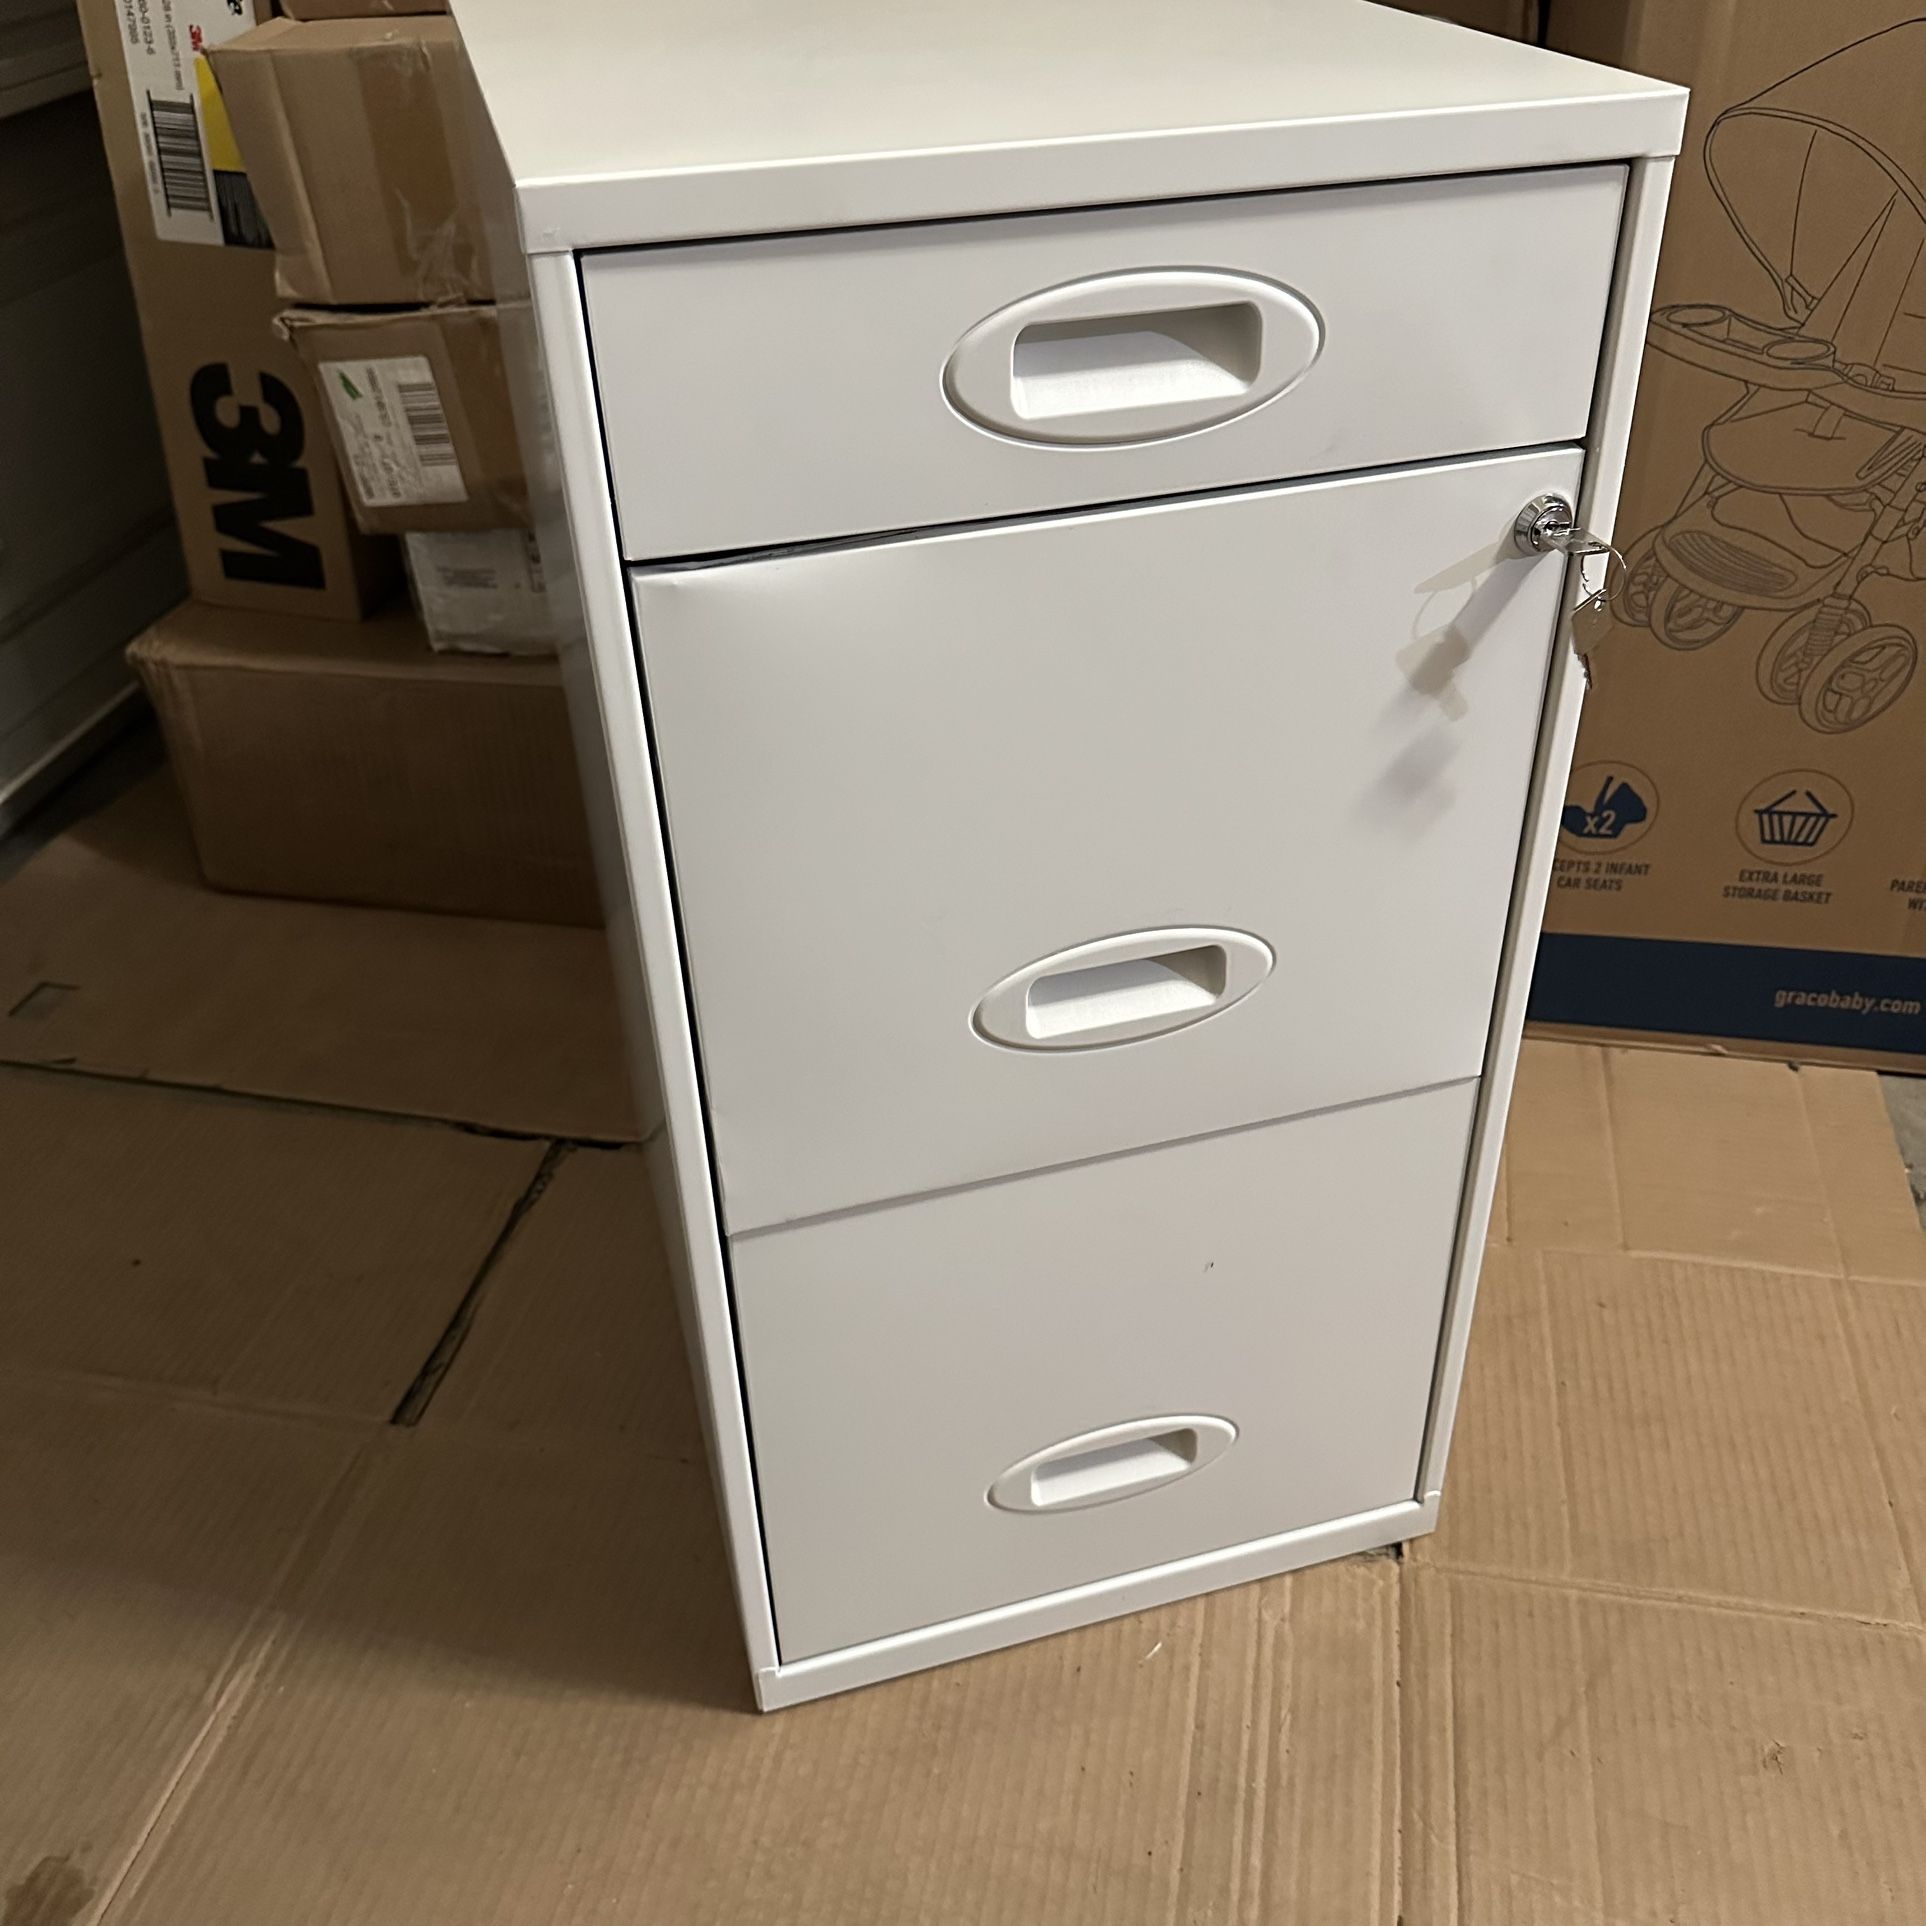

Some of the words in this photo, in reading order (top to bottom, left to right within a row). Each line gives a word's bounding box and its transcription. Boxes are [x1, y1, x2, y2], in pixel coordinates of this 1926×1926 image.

[190, 361, 326, 591] 3M
[1583, 810, 1616, 834] x2
[1593, 861, 1602, 874] 2
[1605, 862, 1651, 876] INFANT
[1739, 868, 1779, 884] EXTRA
[1781, 871, 1824, 887] LARGE
[1557, 875, 1581, 889] CAR
[1584, 877, 1623, 891] SEATS
[1722, 885, 1780, 901] STORAGE
[1782, 888, 1832, 904] BASKET
[1774, 989, 1921, 1015] gracobaby.com
